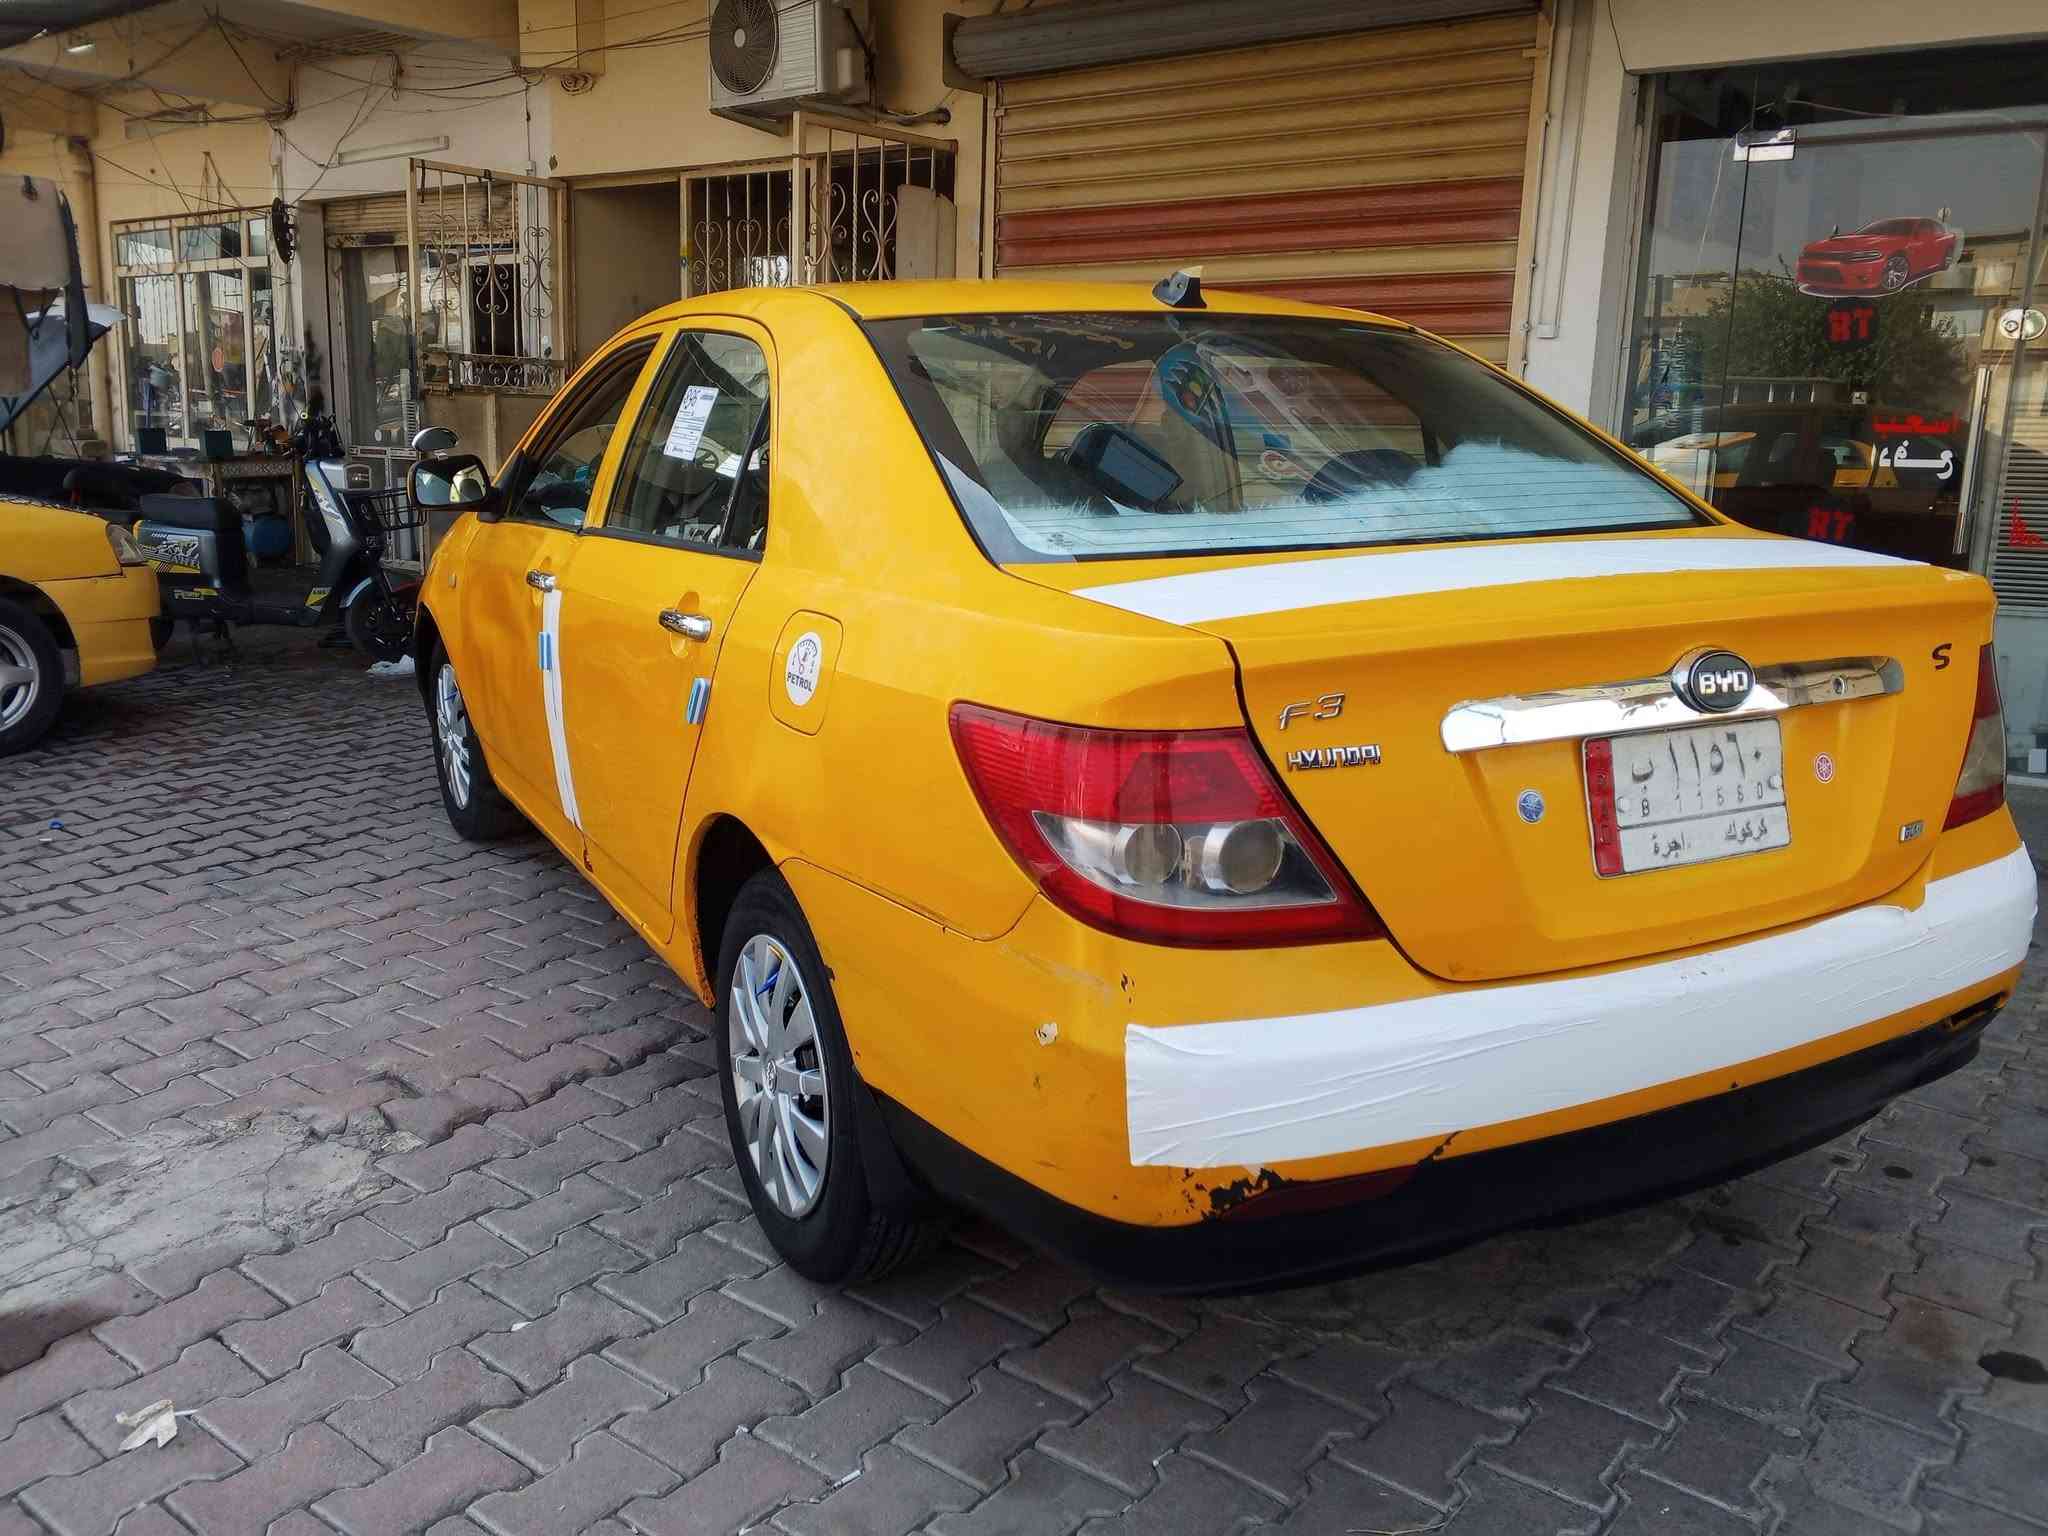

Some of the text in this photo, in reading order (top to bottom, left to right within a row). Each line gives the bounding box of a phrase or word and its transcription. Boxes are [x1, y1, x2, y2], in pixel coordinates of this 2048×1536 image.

[1932, 643, 1952, 670] S
[786, 671, 813, 693] PETROL
[1699, 669, 1748, 696] BYD
[1279, 691, 1345, 730] F3
[1286, 744, 1381, 771] HYUNDAI
[1724, 817, 1768, 844] كركوك
